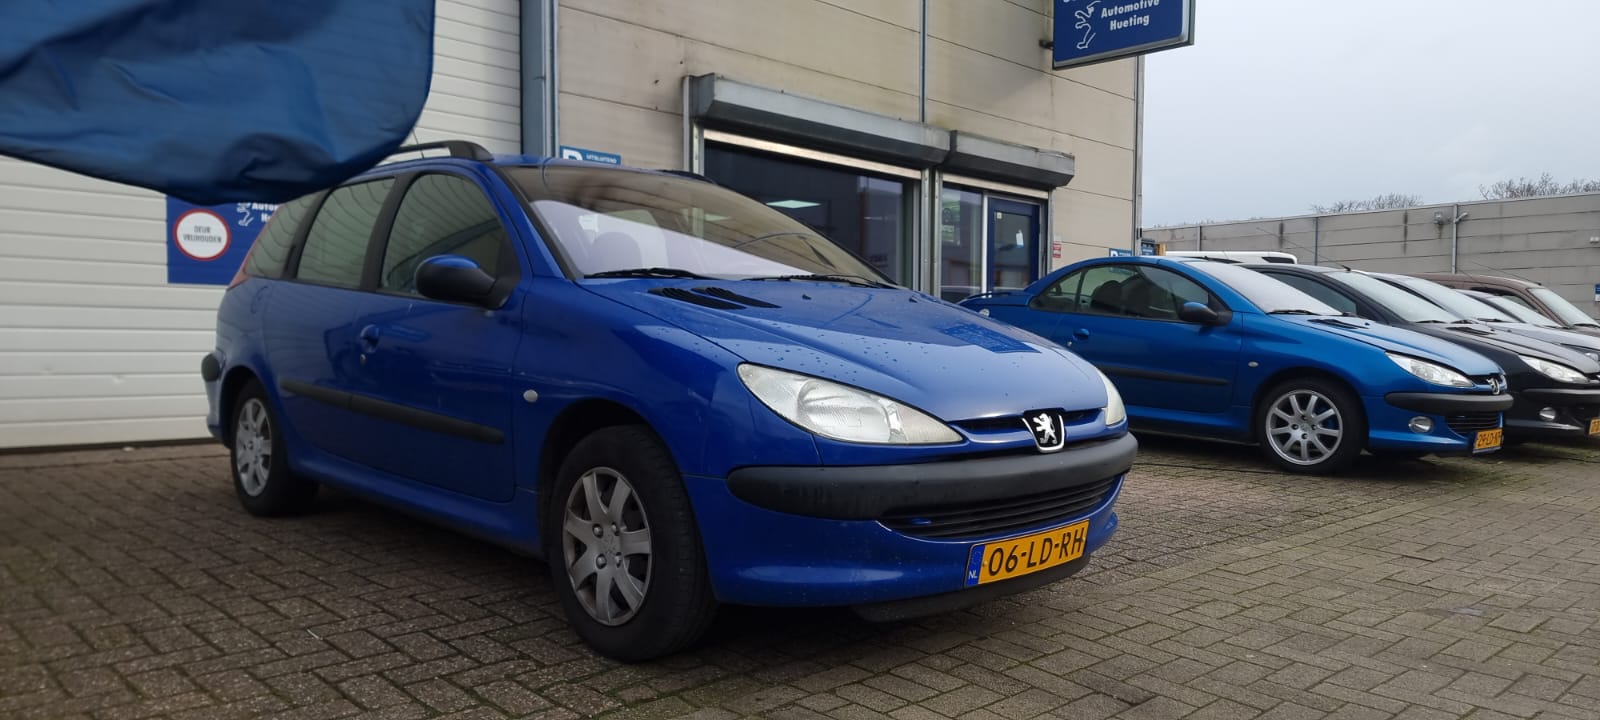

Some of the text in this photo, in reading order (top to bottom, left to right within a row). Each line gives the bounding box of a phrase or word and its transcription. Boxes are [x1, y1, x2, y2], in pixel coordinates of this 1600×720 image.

[1101, 0, 1160, 18] Automotive
[1109, 15, 1150, 31] Hueting
[988, 527, 1085, 576] 06-LD-RH
[968, 569, 978, 579] NL
